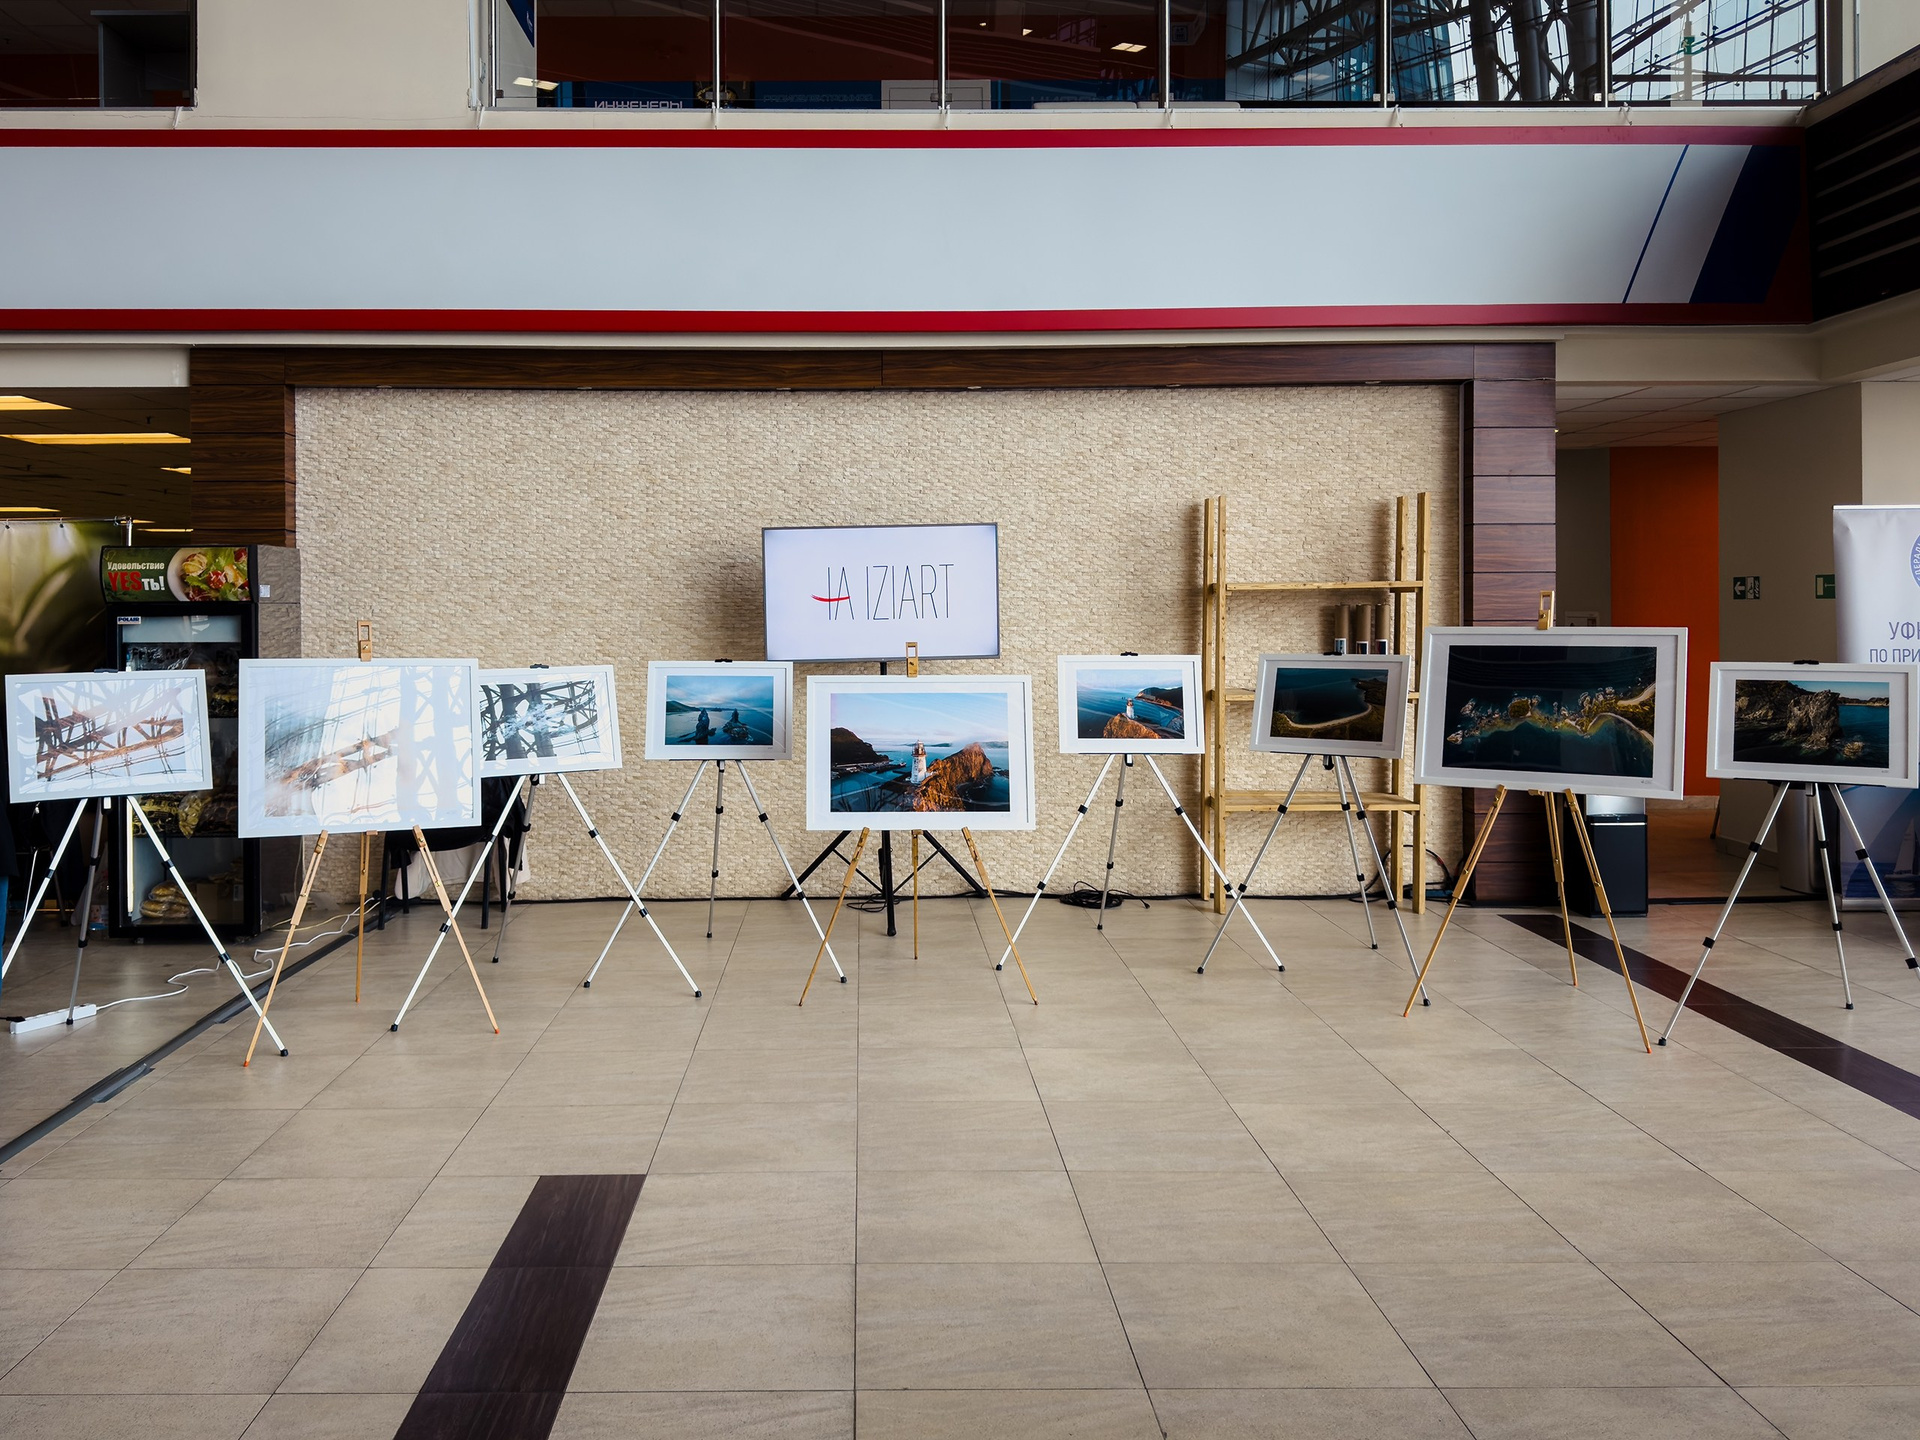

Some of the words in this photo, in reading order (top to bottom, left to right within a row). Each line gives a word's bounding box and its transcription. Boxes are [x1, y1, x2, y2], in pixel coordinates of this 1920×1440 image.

[107, 561, 165, 570] Удовольствие
[865, 564, 954, 620] IZIART
[1889, 622, 1920, 640] УФ
[1870, 649, 1887, 662] ПО
